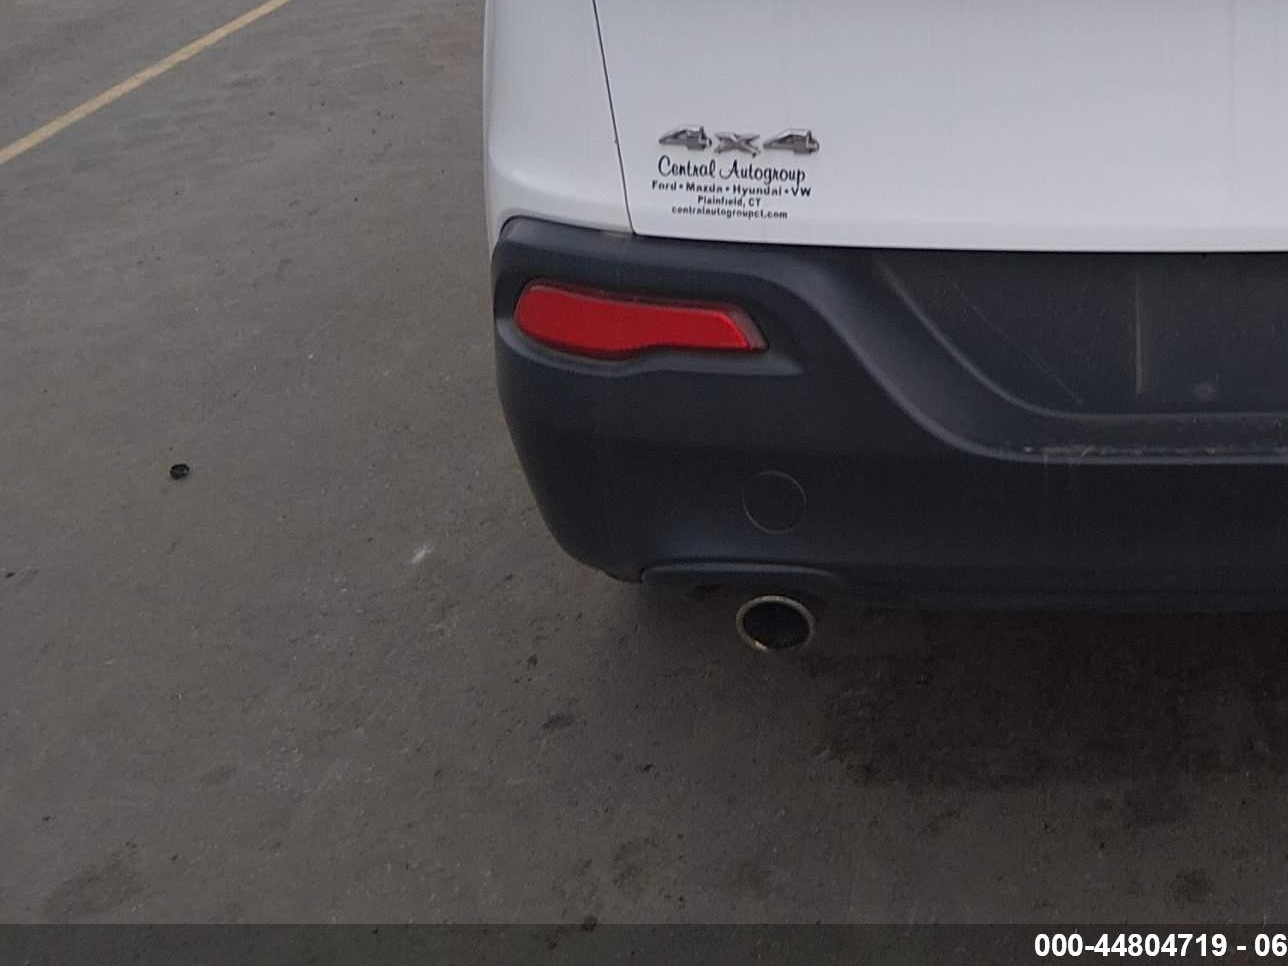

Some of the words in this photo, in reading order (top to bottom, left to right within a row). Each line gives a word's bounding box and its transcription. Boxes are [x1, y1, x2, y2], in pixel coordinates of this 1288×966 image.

[657, 154, 716, 177] Central
[719, 159, 806, 187] Autogroup
[652, 179, 677, 191] Ford
[686, 183, 723, 193] Mazda
[732, 184, 782, 197] Hyundai
[791, 186, 811, 197] VW
